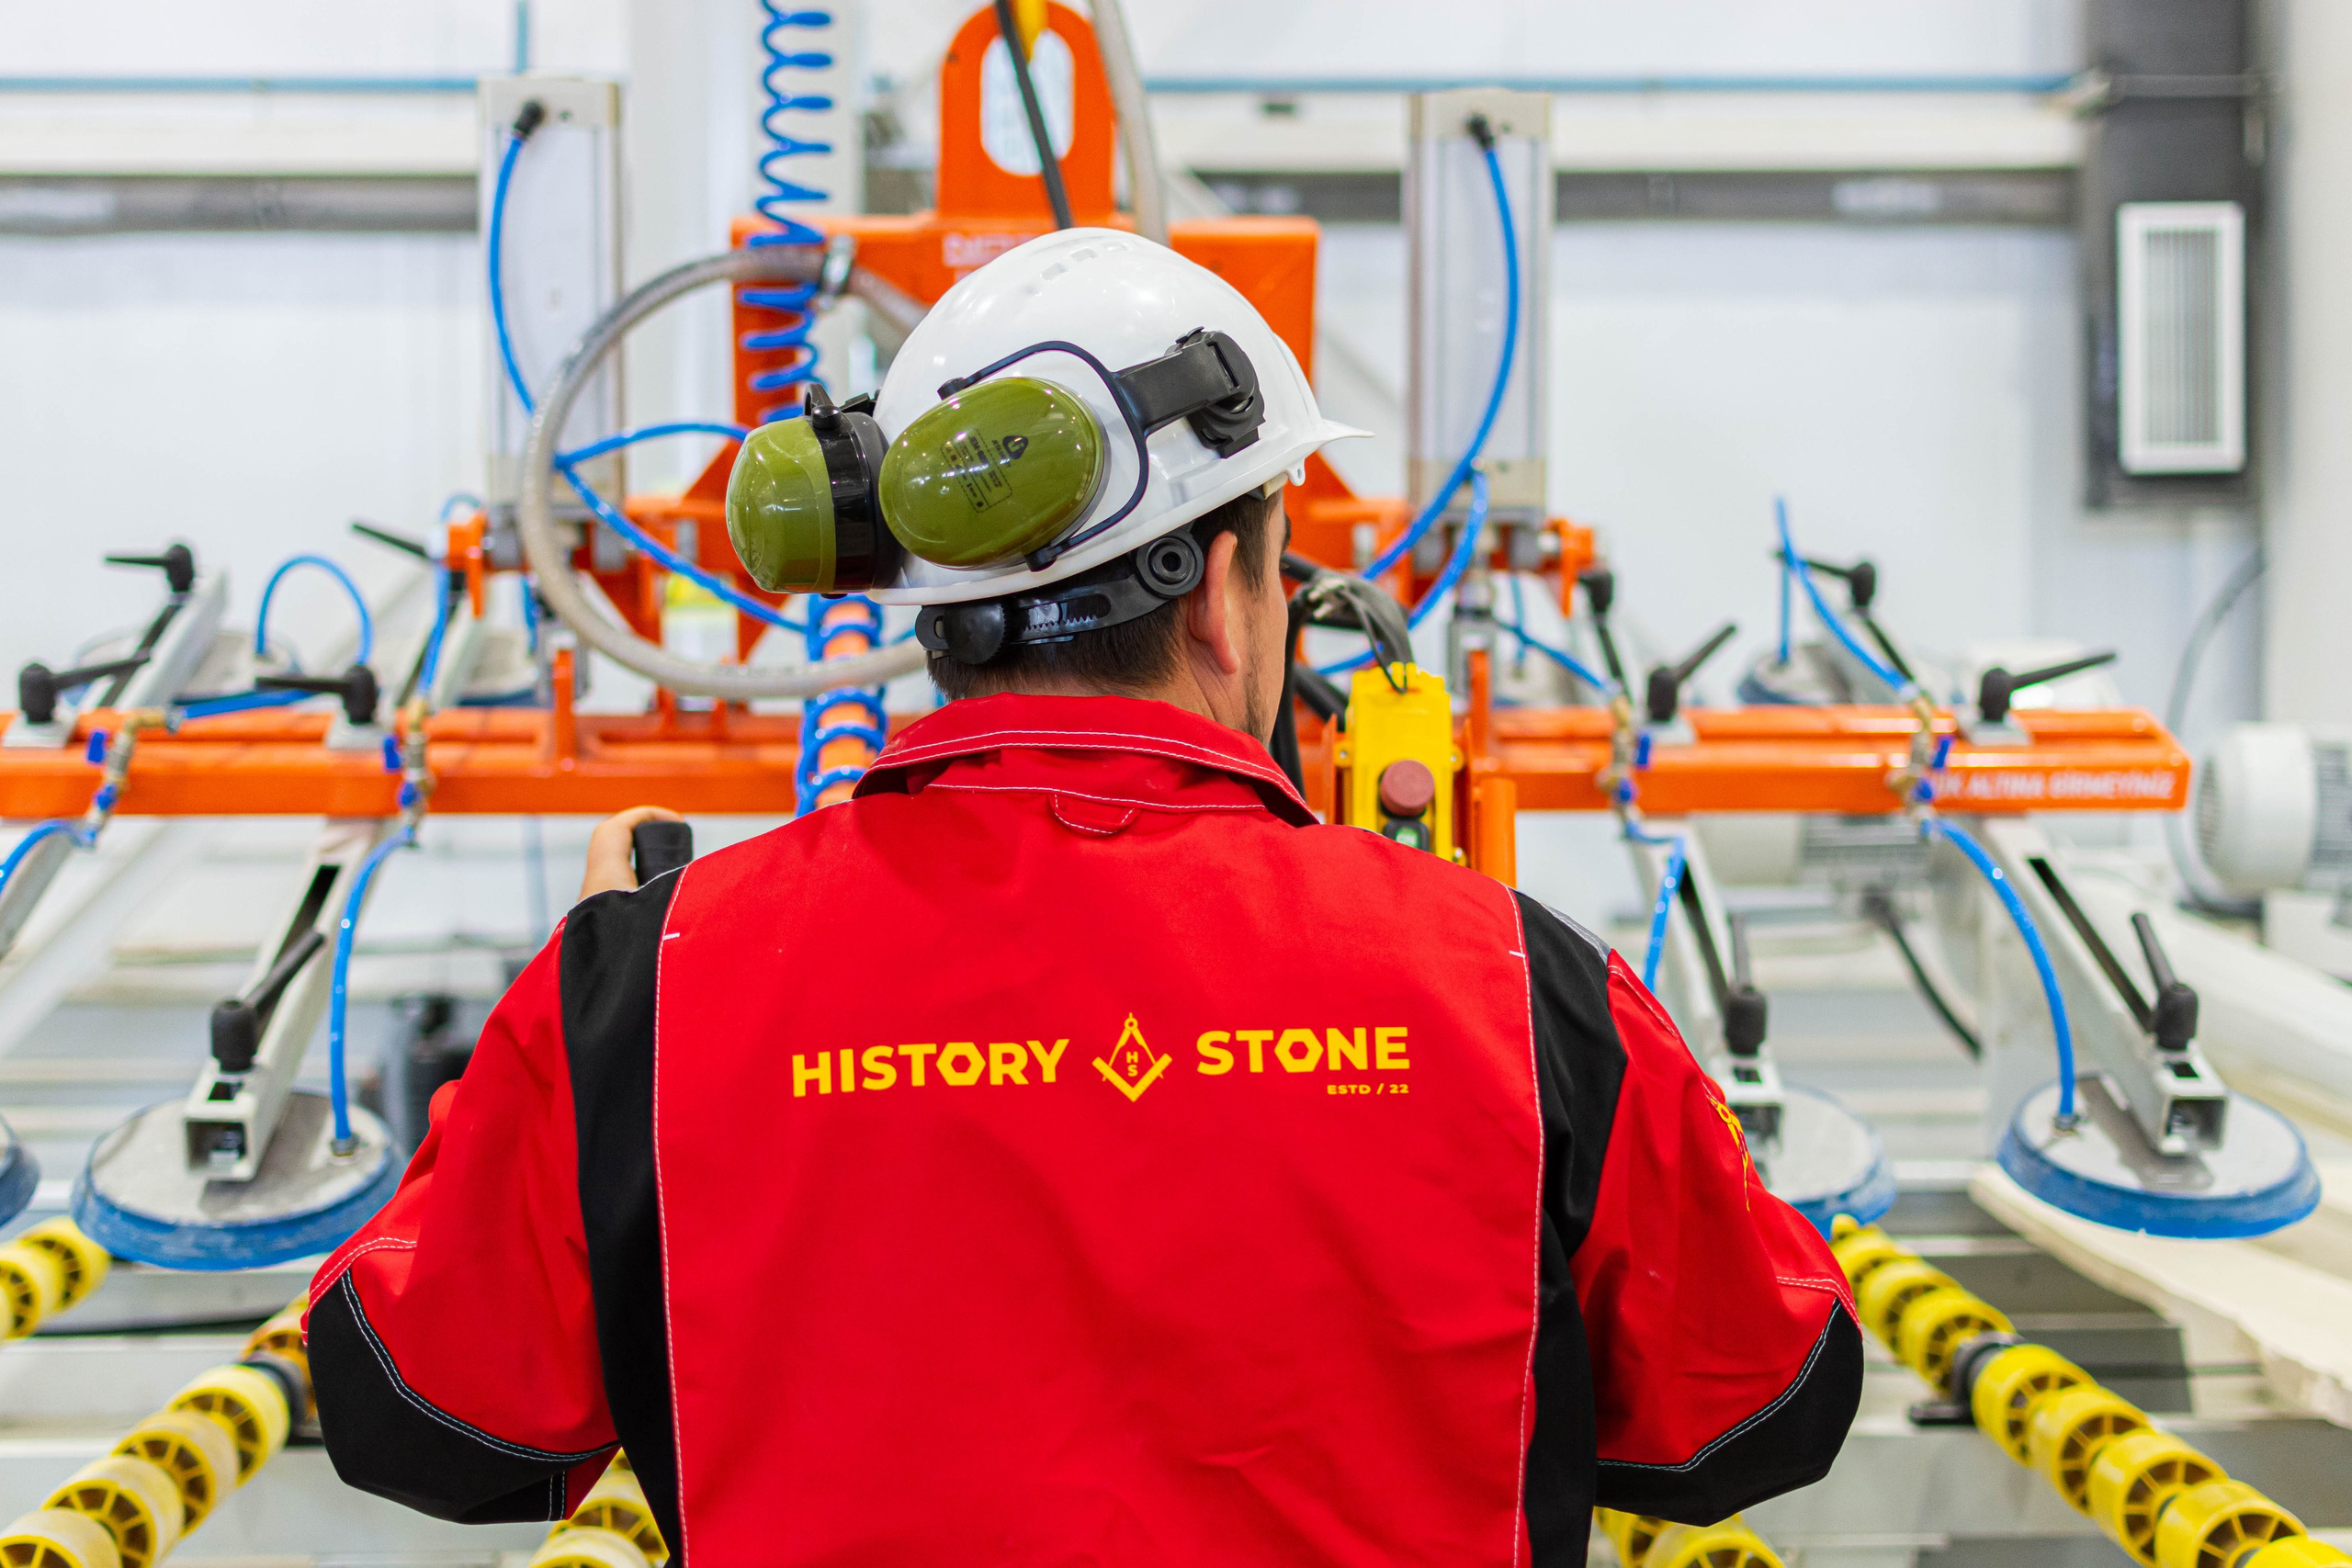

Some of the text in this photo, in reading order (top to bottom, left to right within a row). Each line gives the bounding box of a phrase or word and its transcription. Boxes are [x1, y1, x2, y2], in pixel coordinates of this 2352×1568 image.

[792, 1038, 1069, 1098] HISTORY
[1196, 1026, 1410, 1076] STONE
[1327, 1084, 1371, 1095] ESTD
[1389, 1083, 1409, 1094] 22
